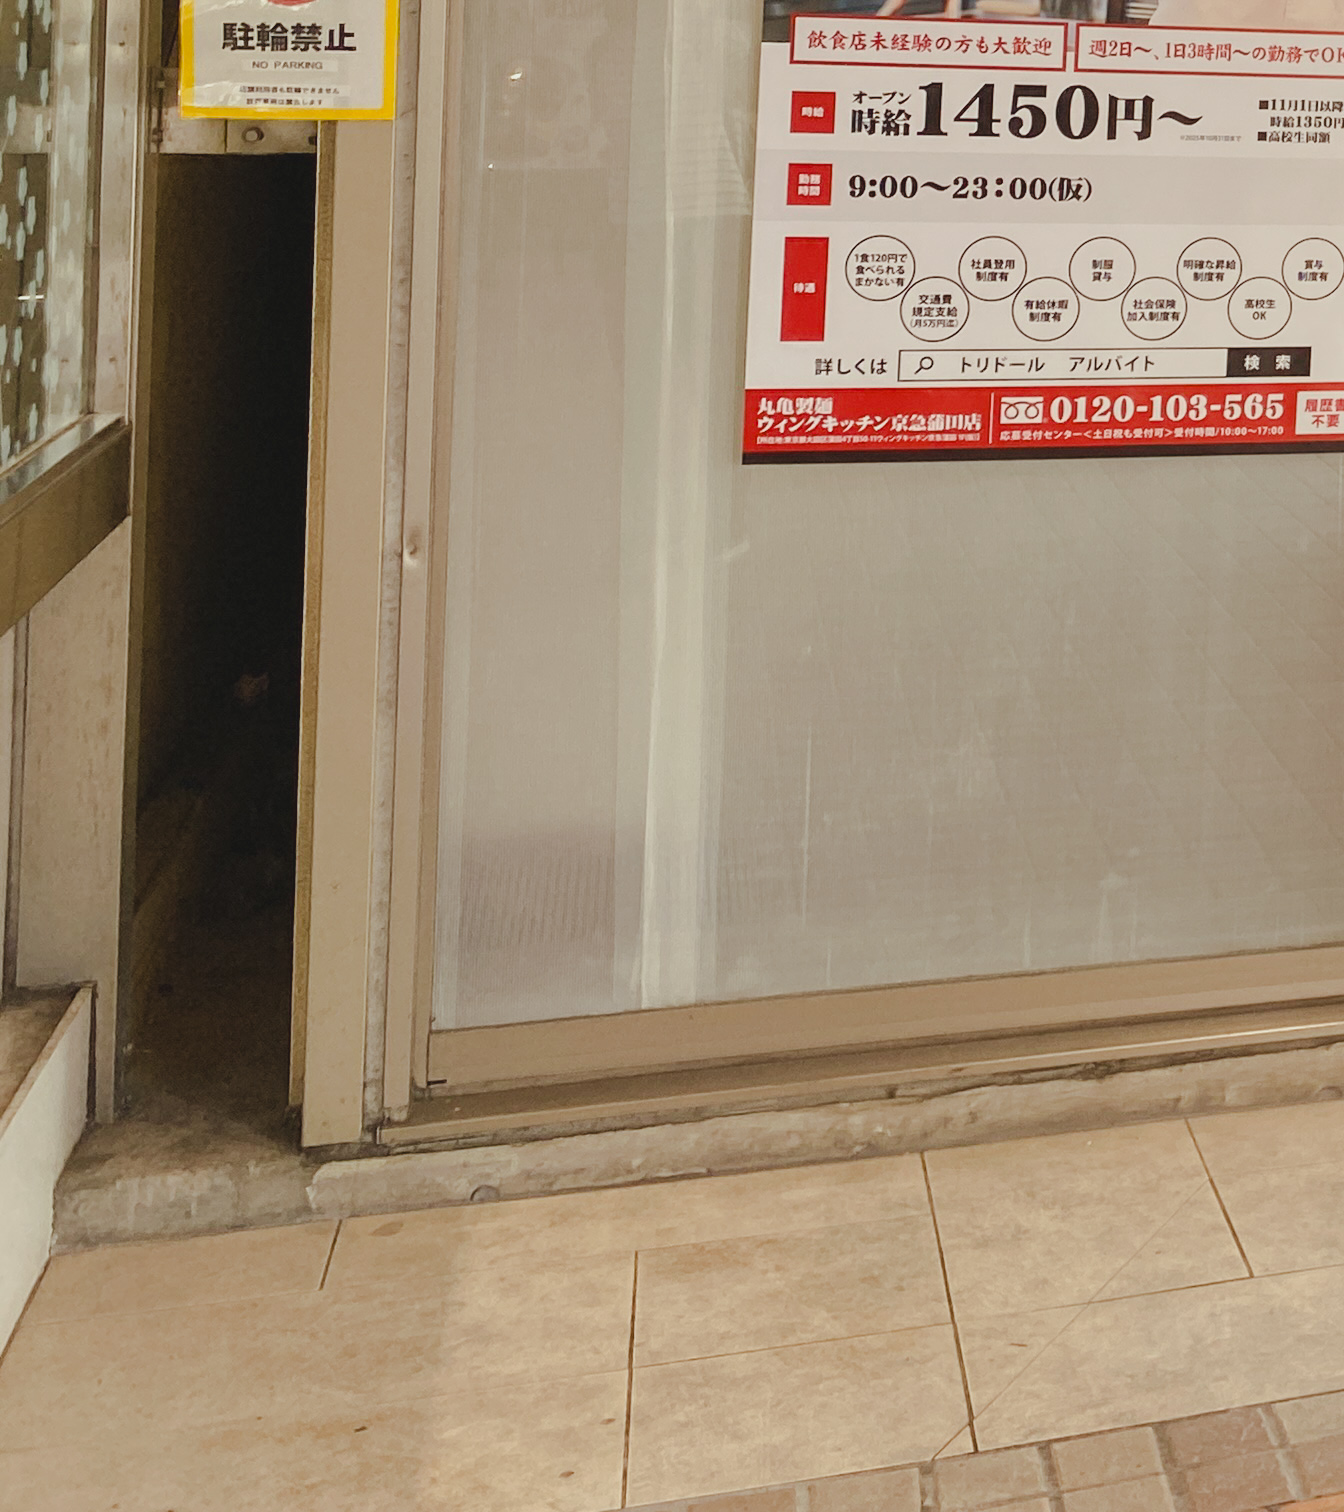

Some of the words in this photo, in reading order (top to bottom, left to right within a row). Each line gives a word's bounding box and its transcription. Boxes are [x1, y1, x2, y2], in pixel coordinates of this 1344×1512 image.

[221, 22, 357, 52] 駐輪禁止
[807, 30, 1053, 57] 飲食店未経験の方も大歓迎
[252, 61, 269, 70] NO
[273, 61, 323, 70] PARKING
[852, 91, 912, 105] オープン
[855, 265, 905, 275] 食べられる
[918, 294, 952, 305] 交通費
[1132, 299, 1176, 310] 社会保険
[1244, 299, 1276, 309] 高校生
[1252, 311, 1267, 321] OK
[814, 357, 887, 376] 詳しくは
[961, 356, 1045, 373] トリドール
[1069, 355, 1155, 372] アルバイト
[757, 397, 833, 416] 丸亀製麺
[1050, 394, 1285, 424] 0120-103-565
[757, 413, 982, 434] ウィングキッチン京急蒲田店
[1311, 414, 1340, 428] 不要
